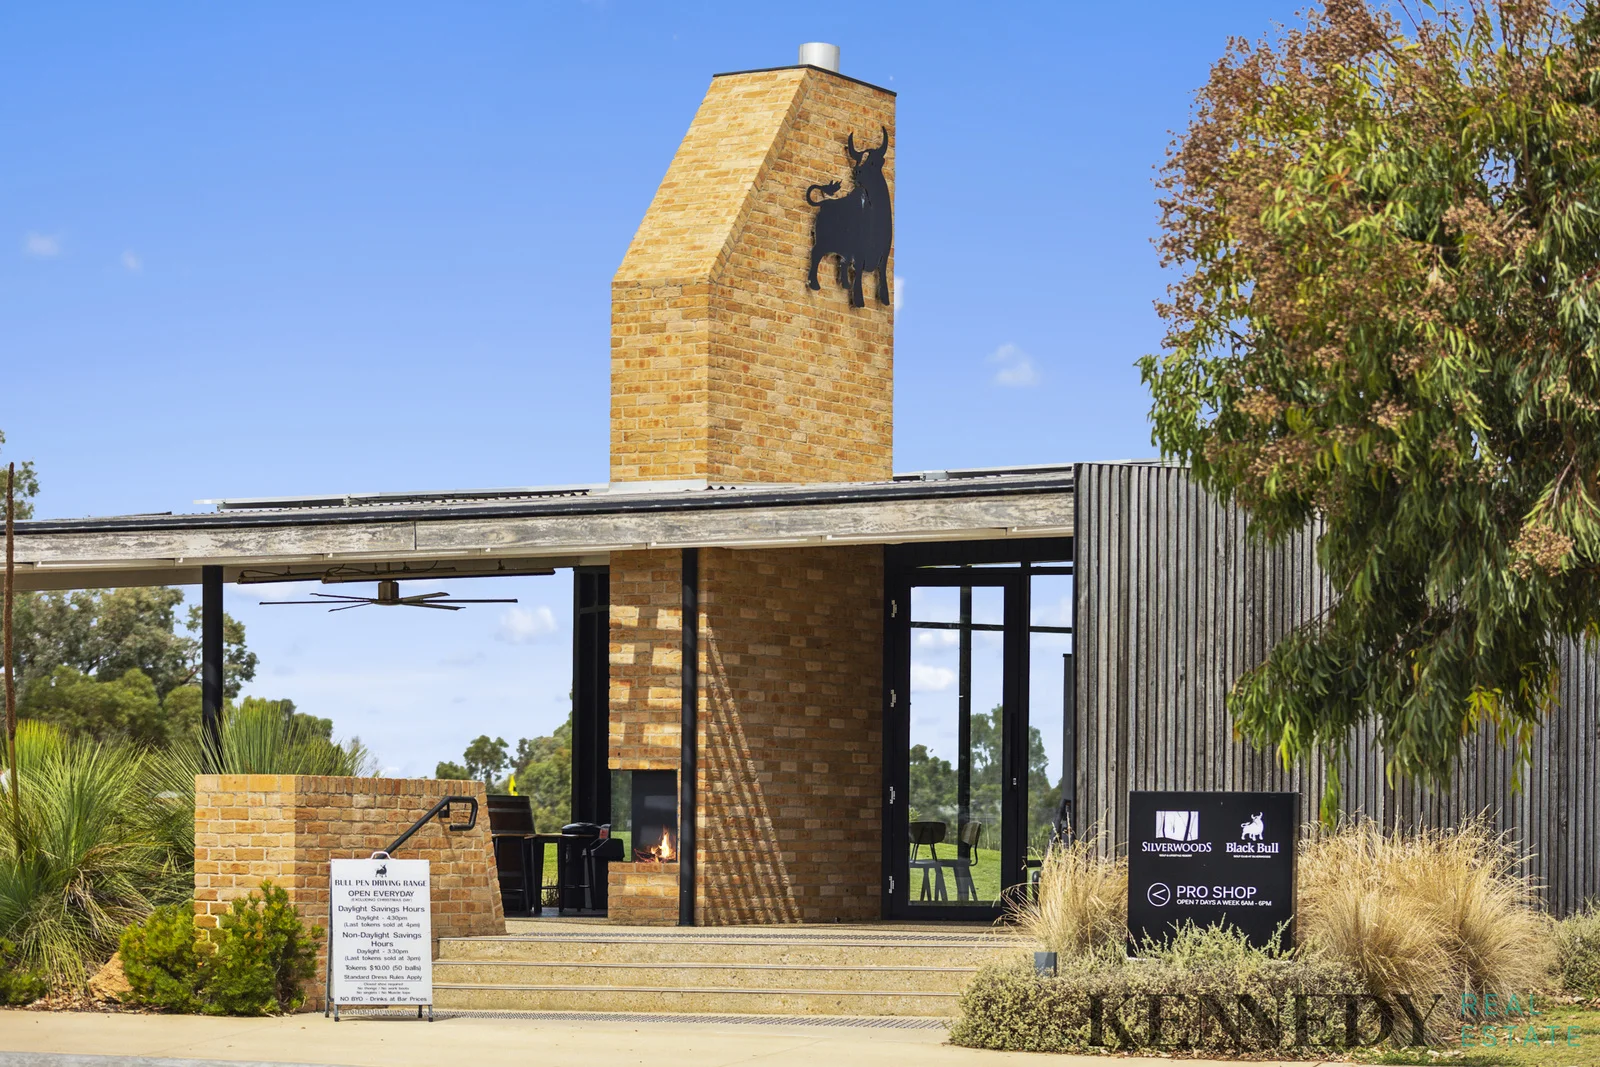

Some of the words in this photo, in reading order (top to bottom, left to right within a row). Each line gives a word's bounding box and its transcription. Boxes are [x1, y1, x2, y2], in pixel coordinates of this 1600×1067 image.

[1142, 841, 1212, 852] SILVERWOODS
[1226, 842, 1255, 853] Black
[1257, 842, 1279, 853] Bull
[1177, 886, 1208, 898] PRO
[1213, 886, 1256, 898] SHOP
